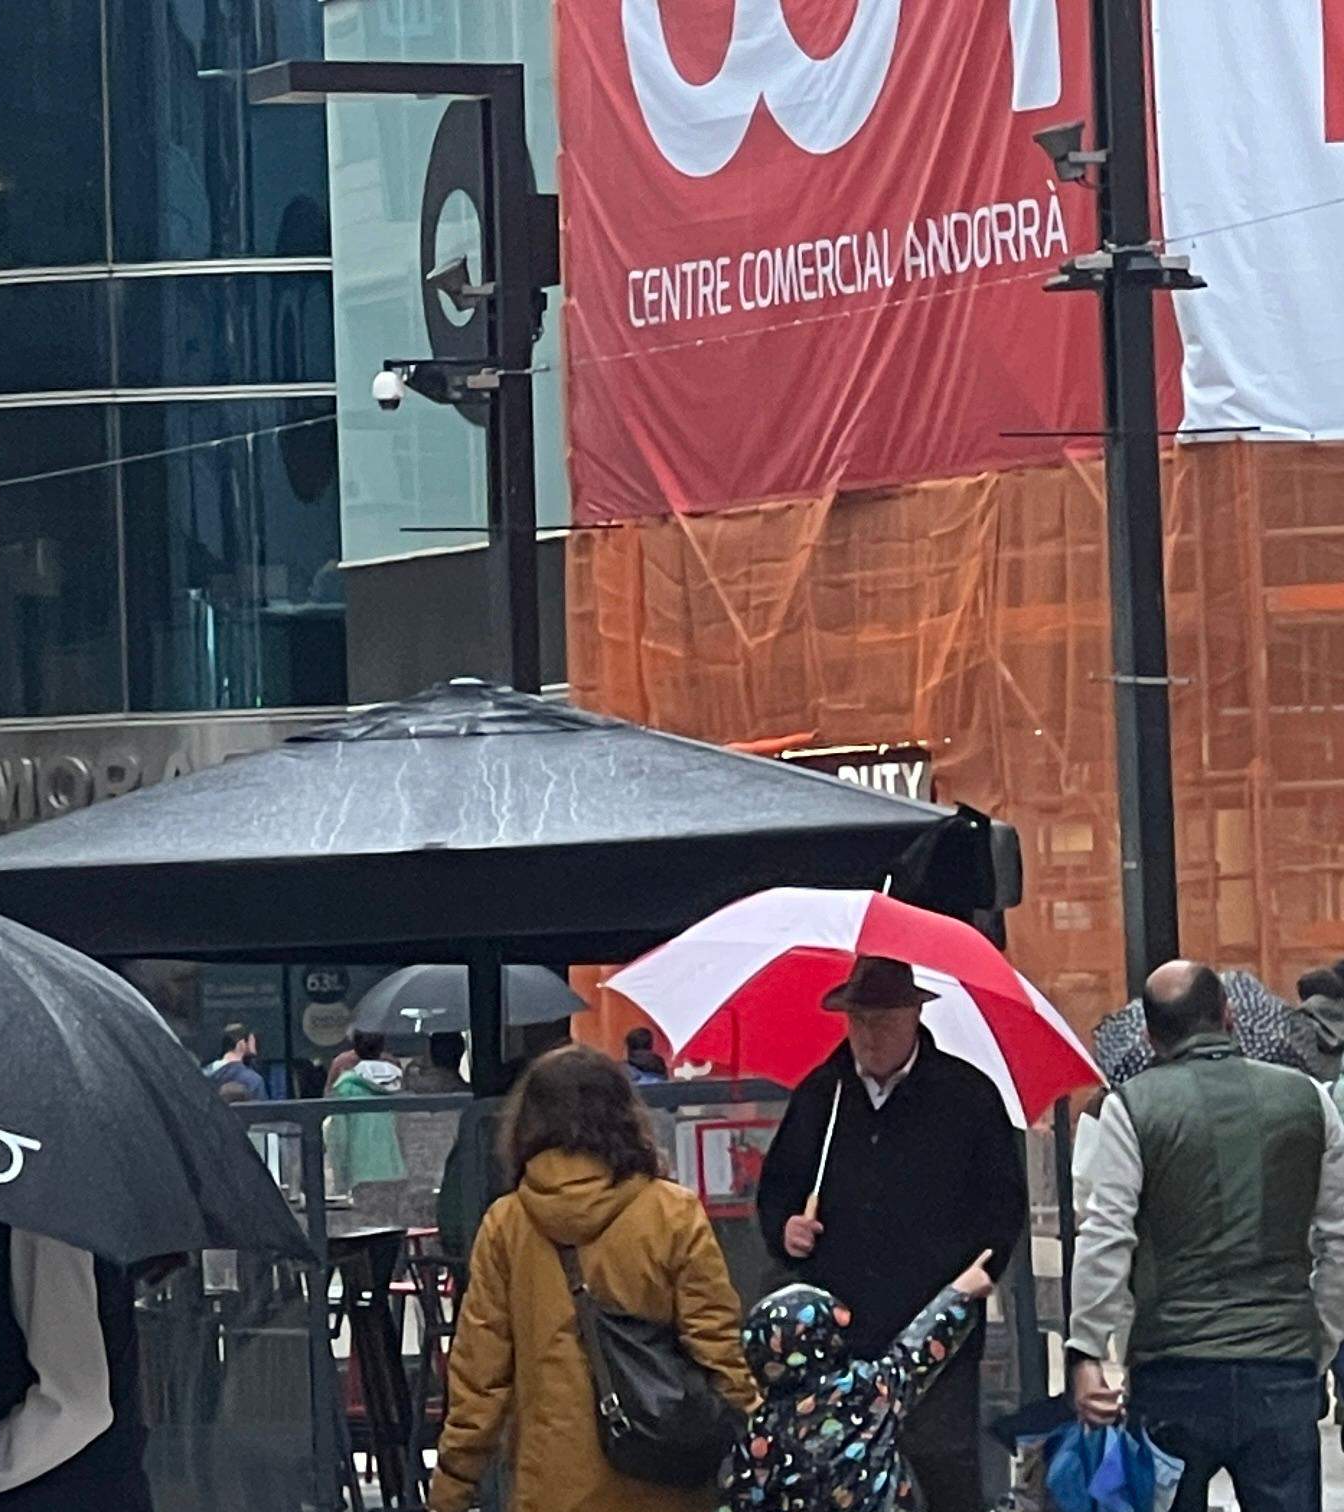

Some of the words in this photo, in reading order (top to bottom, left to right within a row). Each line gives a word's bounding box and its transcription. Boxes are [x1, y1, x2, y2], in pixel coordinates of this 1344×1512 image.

[628, 256, 732, 328] CENTRE
[738, 229, 895, 310] COMERCIAL
[903, 180, 1069, 282] ANDORRÀ
